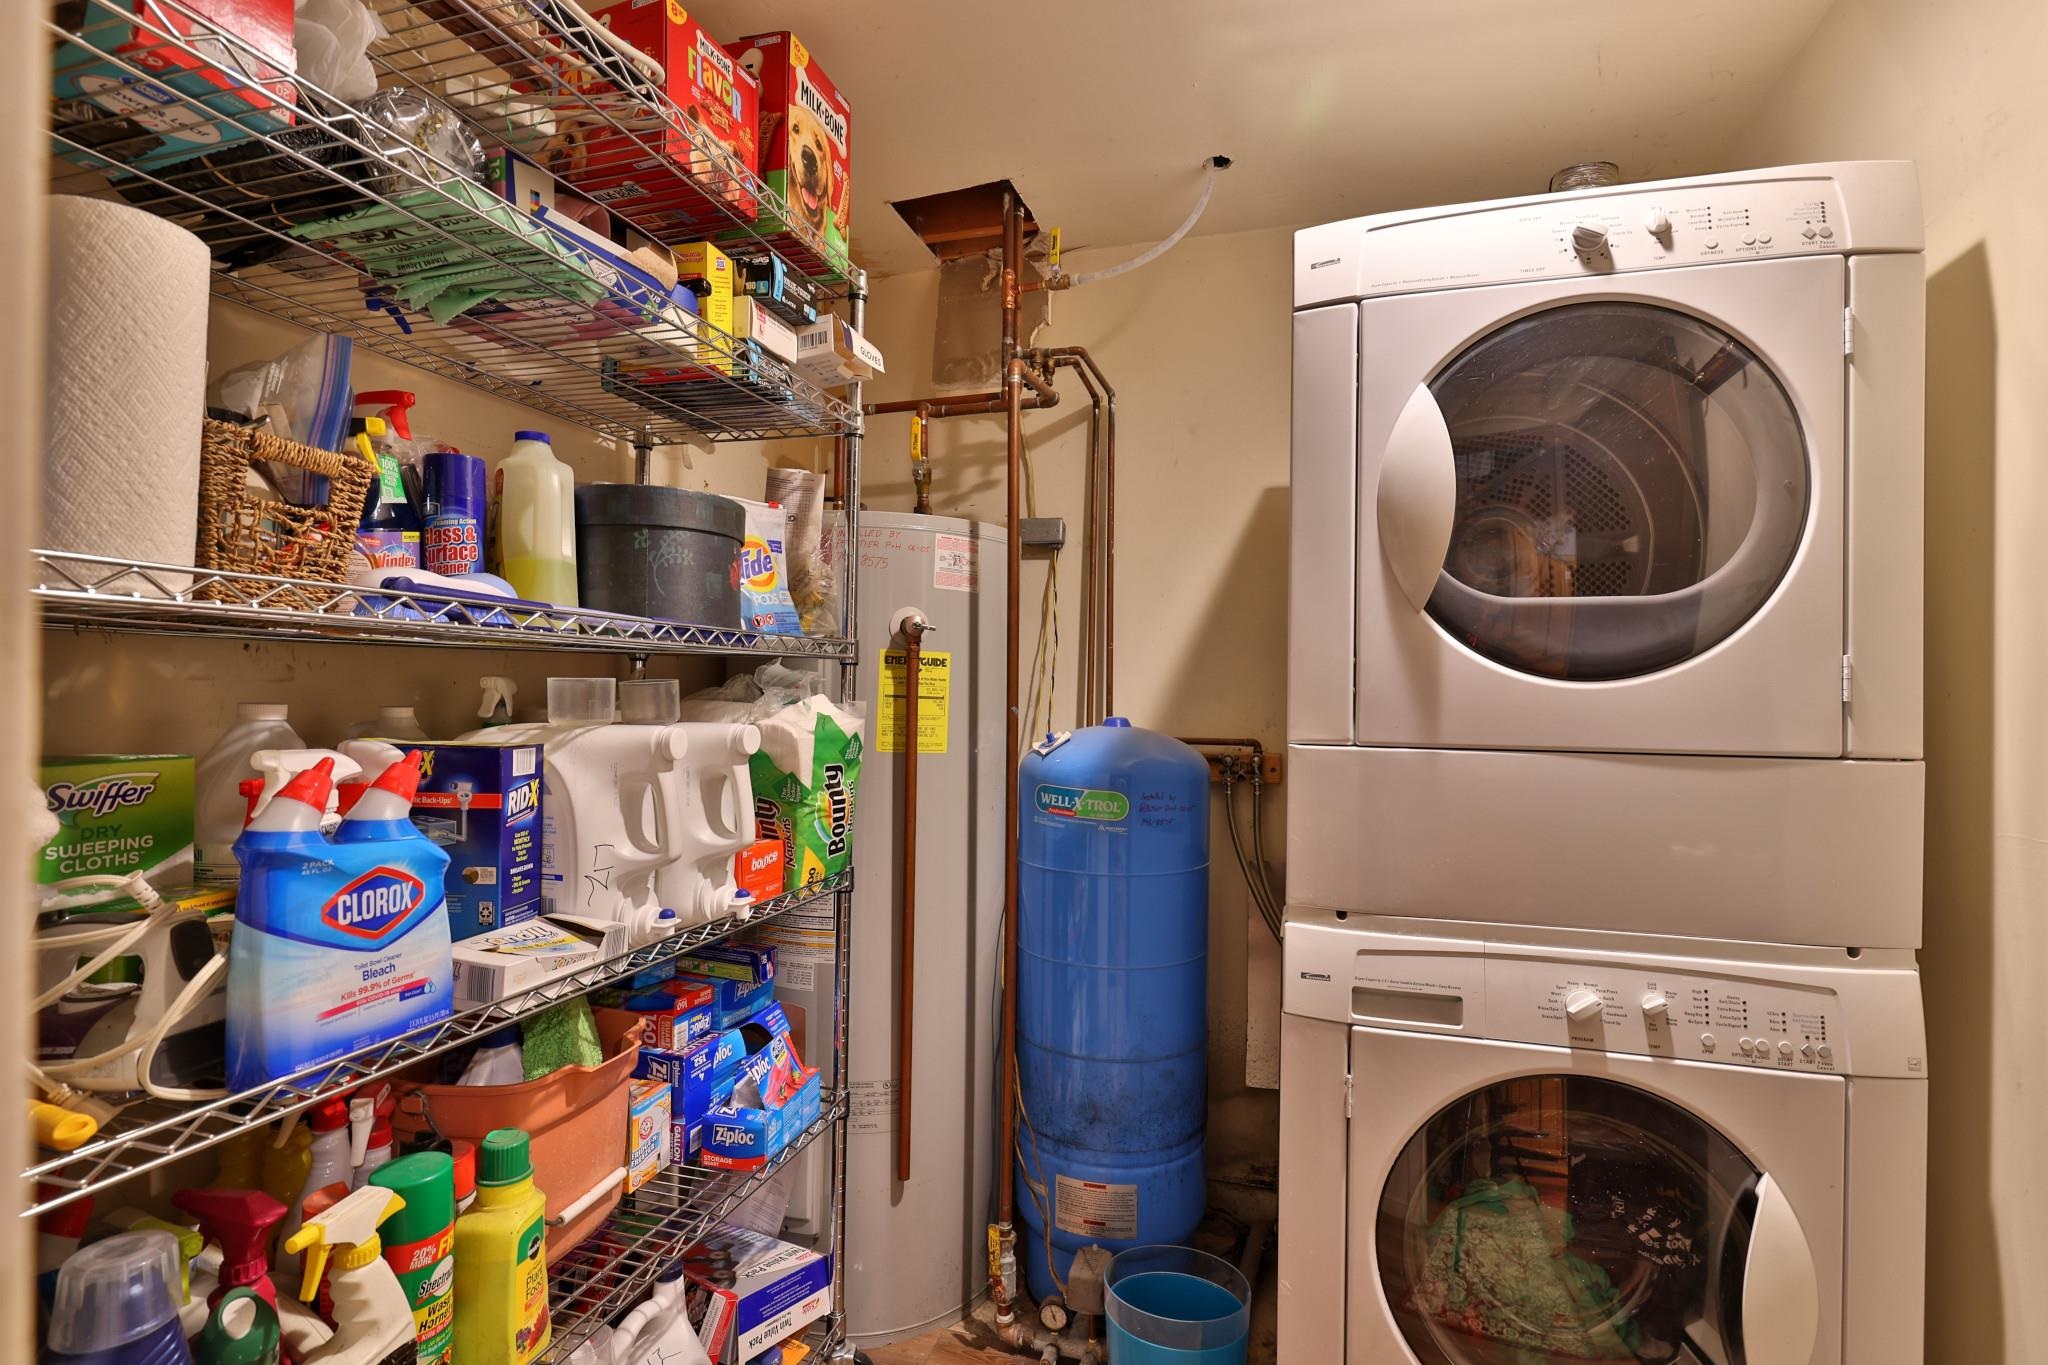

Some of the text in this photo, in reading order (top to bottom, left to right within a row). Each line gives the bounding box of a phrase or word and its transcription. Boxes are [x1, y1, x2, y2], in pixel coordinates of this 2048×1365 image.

[699, 37, 731, 77] MILK-BONE
[800, 80, 844, 146] MILK-BONE
[859, 346, 882, 367] GLOVES
[424, 526, 462, 546] Glass
[464, 525, 477, 543] &
[889, 530, 902, 539] BY
[425, 543, 479, 563] Surface
[428, 561, 470, 576] Cleaner
[741, 549, 773, 580] Tide
[48, 781, 154, 817] Swiffer
[507, 779, 540, 817] RID-X
[847, 780, 855, 833] Napkins
[824, 763, 847, 860] Bounty
[80, 824, 123, 841] DRY
[785, 816, 796, 868] Napkins
[45, 835, 154, 861] SWEEPING
[60, 853, 139, 873] CLOTHS
[309, 859, 335, 868] PACK
[751, 850, 779, 872] bounce
[337, 880, 413, 926] CLOROX
[354, 953, 402, 971] Toilet Bowl Cleaner
[362, 963, 396, 981] Bleach
[341, 990, 357, 1001] Kills
[358, 982, 382, 996] 99.9%
[383, 978, 391, 987] of
[676, 1000, 688, 1011] 160
[643, 1014, 657, 1044] 160
[690, 1016, 711, 1031] Ziploc
[694, 1054, 708, 1066] 152
[673, 1125, 681, 1162] GALLON
[715, 1126, 755, 1146] Ziploc
[631, 1143, 656, 1169] FREEZER
[703, 1155, 733, 1165] STORAGE
[409, 1256, 433, 1270] MORE
[412, 1245, 437, 1262] 20%
[526, 1267, 544, 1287] Plant
[744, 1264, 766, 1279] Pack
[526, 1277, 544, 1300] Food
[748, 1318, 792, 1350] Twin Value Pack
